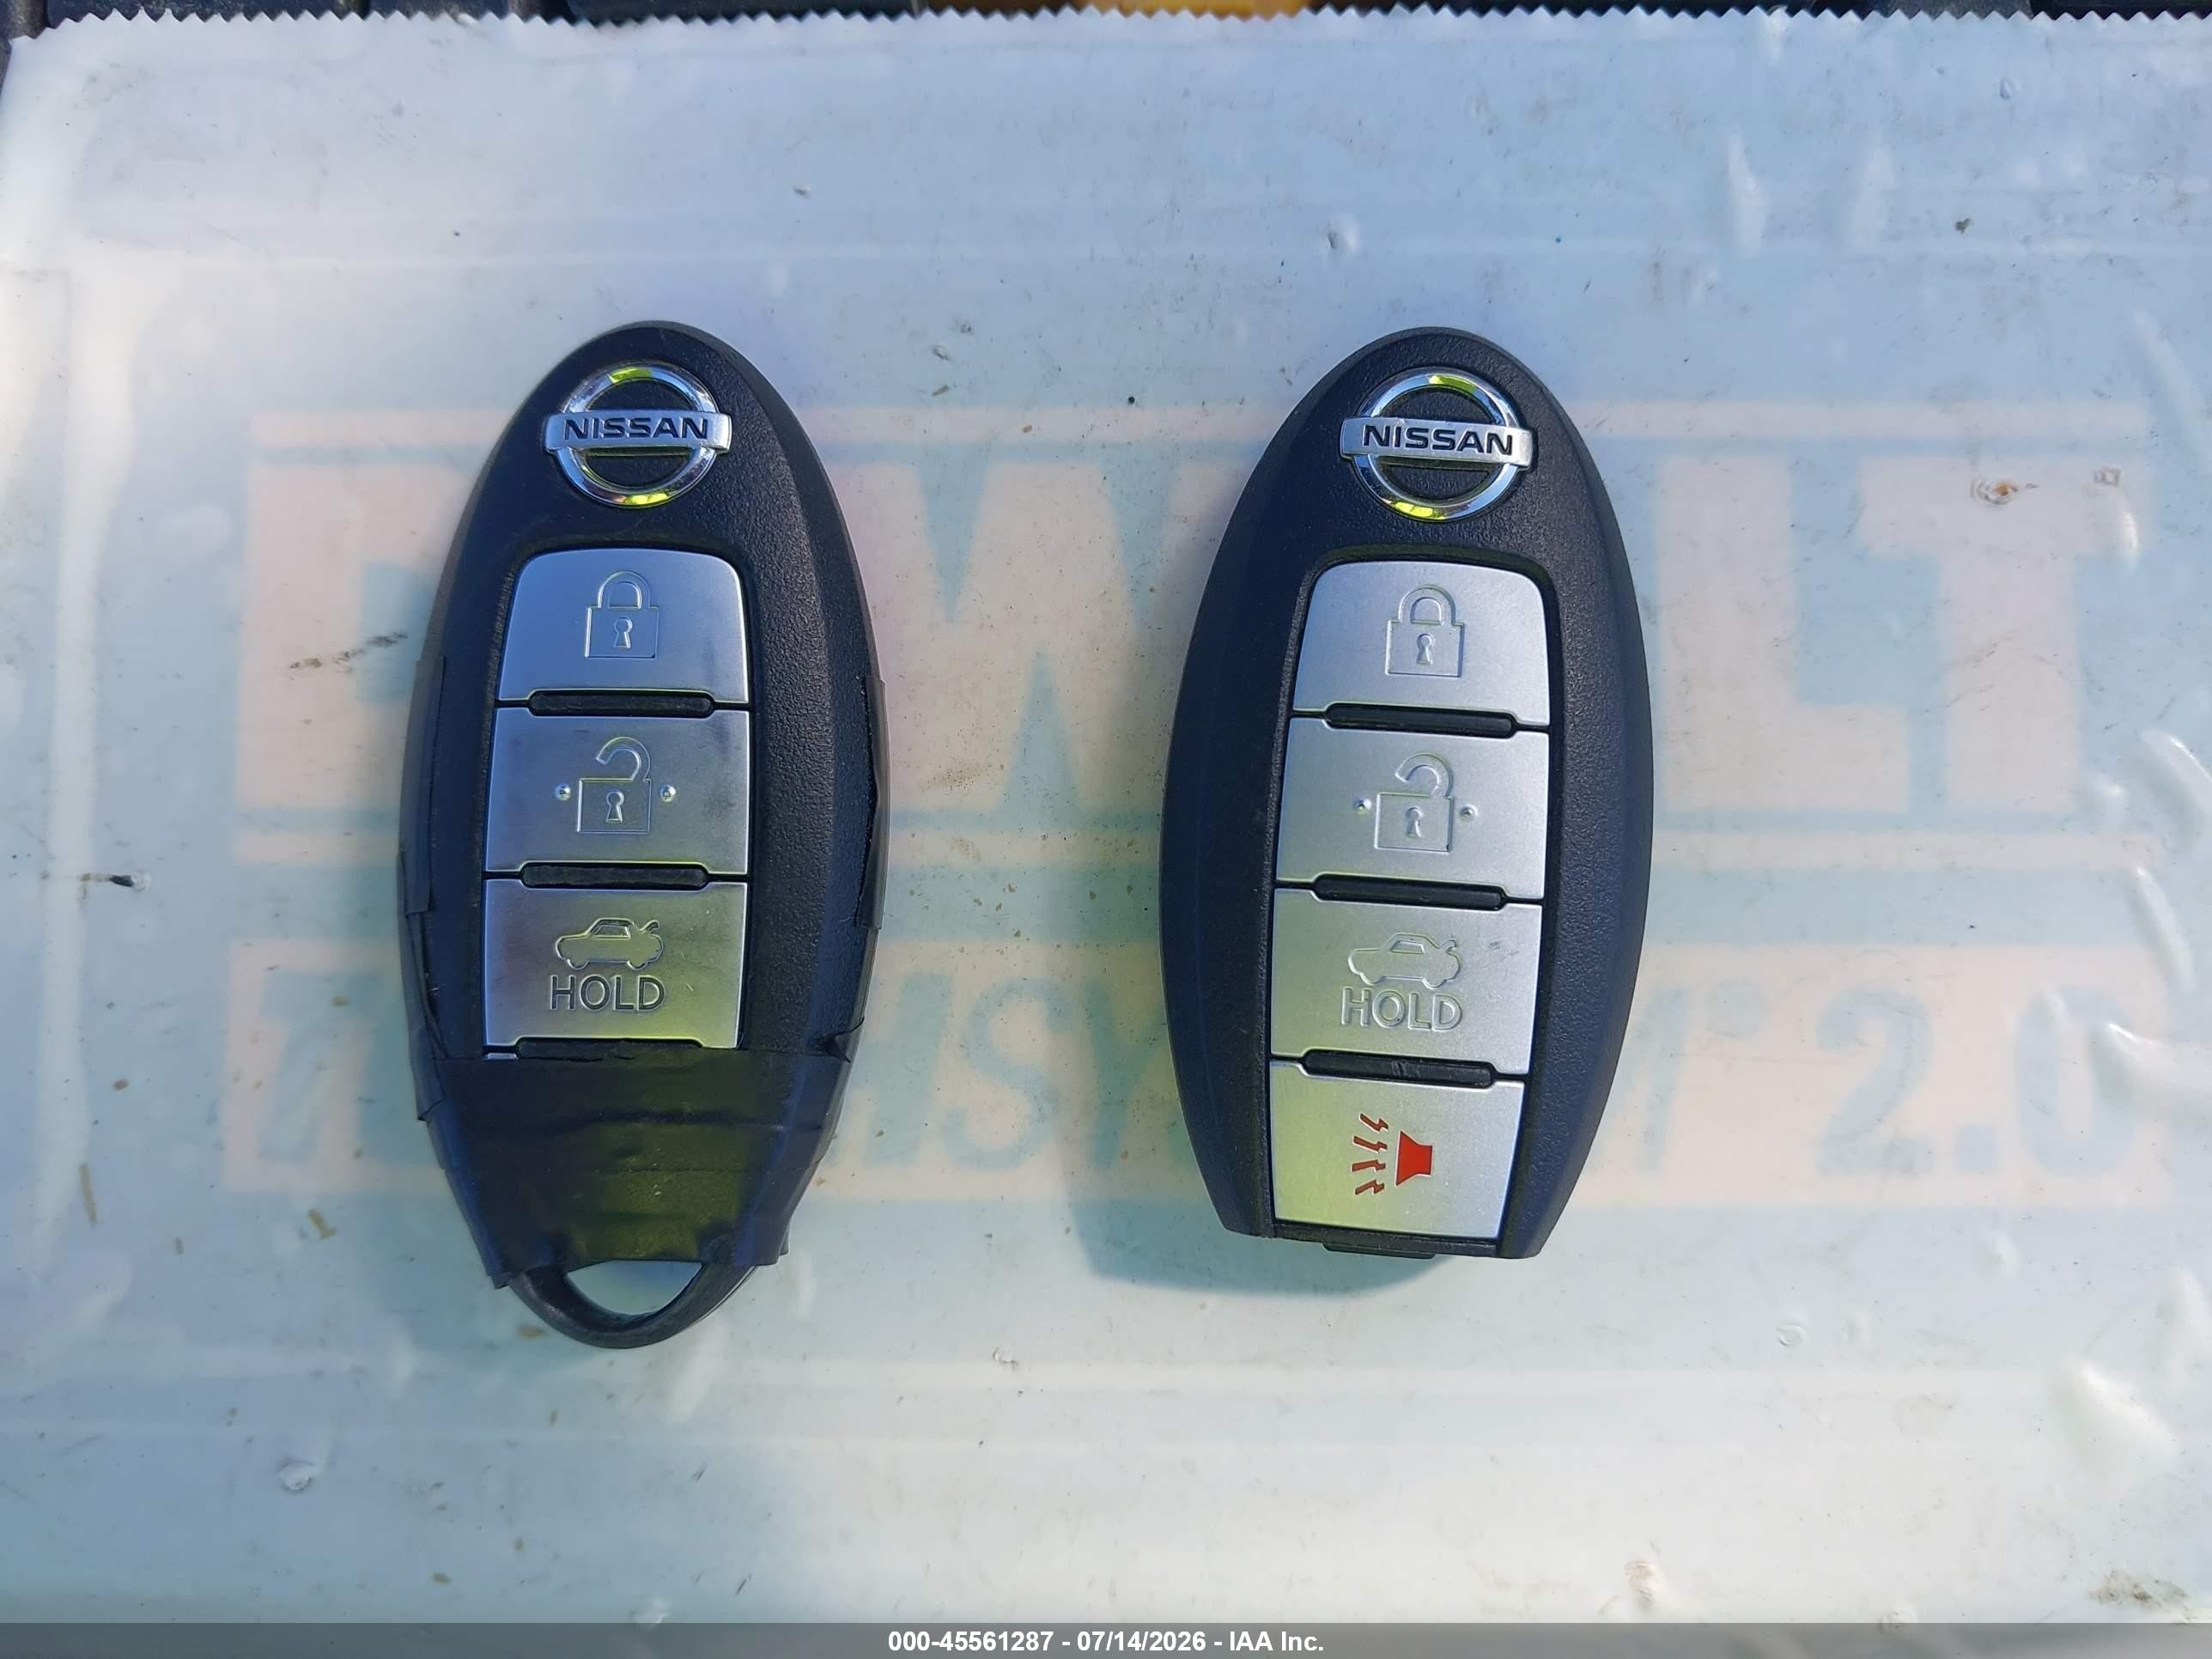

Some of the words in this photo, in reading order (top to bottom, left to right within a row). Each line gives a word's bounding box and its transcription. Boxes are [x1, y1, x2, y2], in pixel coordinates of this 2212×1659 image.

[564, 417, 708, 440] NISSAN
[1362, 424, 1514, 456] NISSAN
[550, 975, 665, 1012] HOLD
[1340, 988, 1462, 1031] HOLD
[1816, 988, 2138, 1175] 2.0
